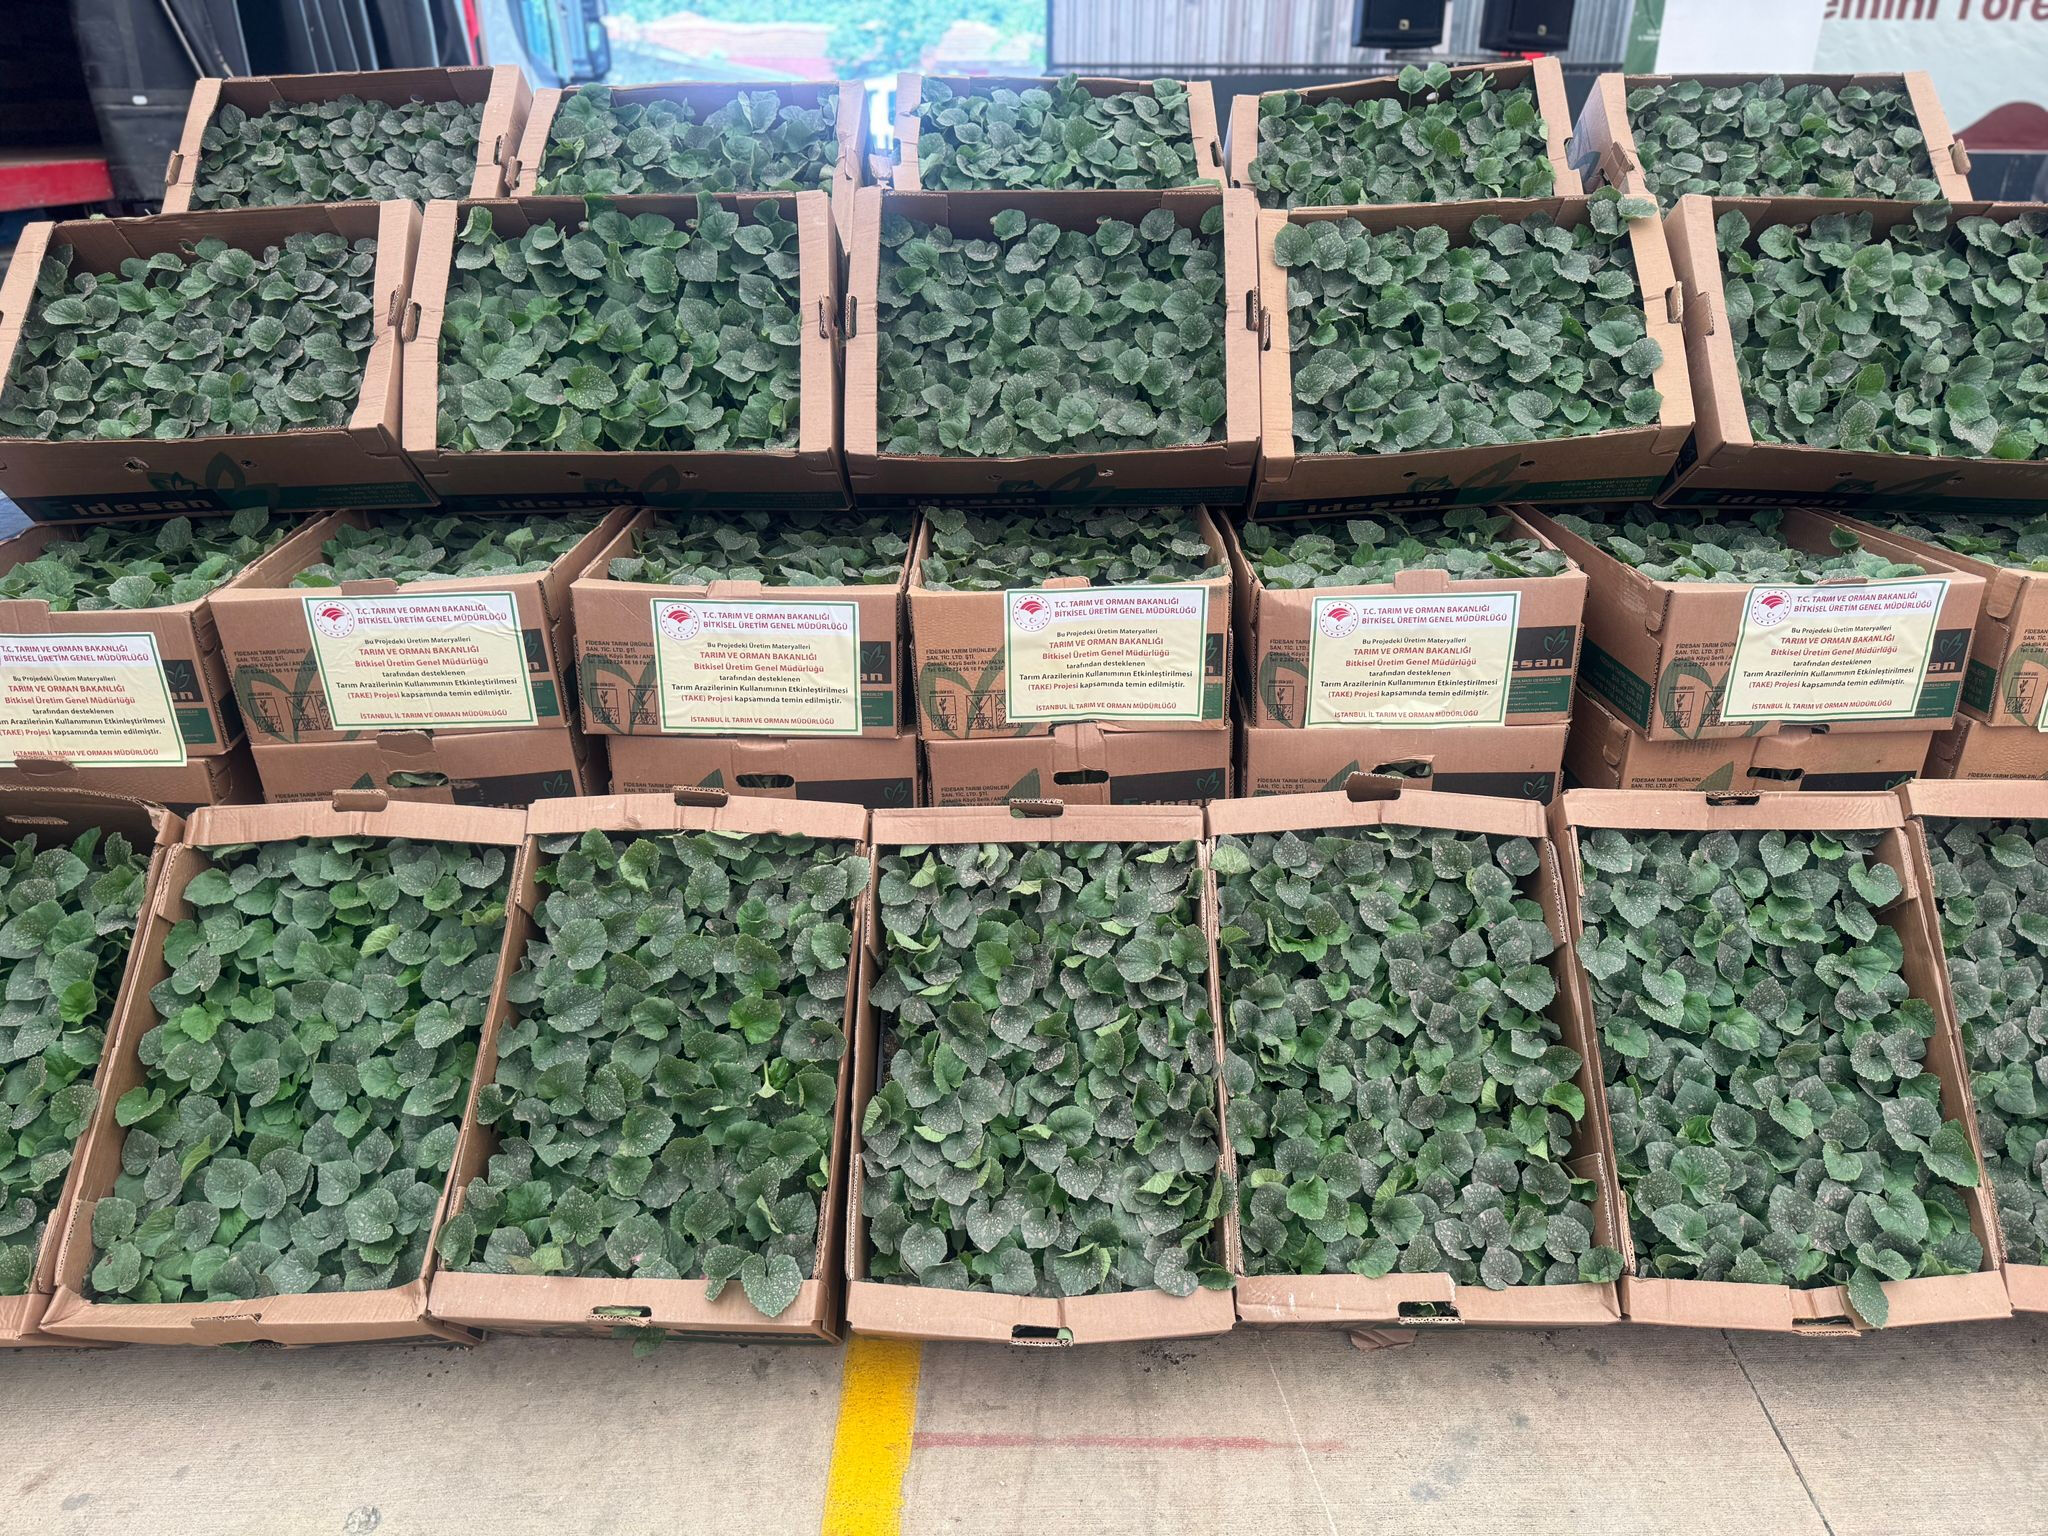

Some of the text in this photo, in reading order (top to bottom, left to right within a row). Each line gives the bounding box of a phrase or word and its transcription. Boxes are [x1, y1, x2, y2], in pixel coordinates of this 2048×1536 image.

[36, 500, 213, 518] Fidesan
[1797, 595, 1810, 603] T.C.
[1848, 594, 1876, 602] ORMAN
[1877, 591, 1918, 600] BAKANLIĞI
[441, 603, 486, 612] BAKANLIĞI
[1069, 599, 1092, 607] TARIM
[1794, 604, 1827, 613] BİTKİSEL
[1828, 604, 1858, 612] ÜRETİM
[1884, 600, 1932, 609] MÜDÜRLÜĞÜ
[1054, 609, 1086, 617] BİTKİSEL
[1089, 607, 1117, 615] ÜRETİM
[1146, 606, 1196, 614] MÜDÜRLÜĞÜ
[1377, 607, 1401, 615] TARIM
[1415, 606, 1445, 614] ORMAN
[1447, 604, 1489, 613] BAKANLIĞI
[358, 616, 392, 624] BİTKİSEL
[393, 615, 425, 624] ÜRETİM
[453, 612, 507, 621] MÜDÜRLÜĞÜ
[787, 612, 829, 620] BAKANLIĞI
[1361, 616, 1395, 624] BİTKİSEL
[1397, 616, 1427, 624] ÜRETİM
[1455, 613, 1507, 622] MÜDÜRLÜĞÜ
[703, 620, 736, 629] BİTKİSEL
[738, 621, 768, 629] ÜRETİM
[1066, 629, 1095, 637] Projedeki
[1119, 637, 1163, 645] BAKANLIĞI
[1852, 633, 1894, 643] BAKANLIĞI
[432, 645, 479, 654] BAKANLIĞI
[772, 643, 810, 651] Materyalleri
[1426, 646, 1471, 654] BAKANLIĞI
[3, 654, 36, 662] BİTKİSEL
[37, 654, 69, 662] ÜRETİM
[97, 653, 149, 661] MÜDÜRLÜĞÜ
[700, 651, 725, 659] TARIM
[740, 652, 770, 660] ORMAN
[1073, 650, 1099, 658] Üretim
[1125, 649, 1169, 657] Müdürlüğü
[726, 663, 752, 671] Üretim
[779, 665, 823, 673] Müdürlüğü
[1066, 661, 1101, 669] tarafından
[1133, 670, 1192, 678] Etkinleştirilmesi
[788, 686, 848, 694] Etkinleştirilmesi
[1028, 683, 1051, 691] (TAKE)
[1053, 682, 1078, 690] Projesi
[1080, 681, 1123, 689] kapsamında
[681, 694, 705, 702] (TAKE)
[707, 695, 733, 703] Projesi
[734, 695, 779, 703] kapsamında
[805, 697, 841, 705] edilmiştir.
[791, 717, 834, 725] MÜDÜRLÜĞÜ
